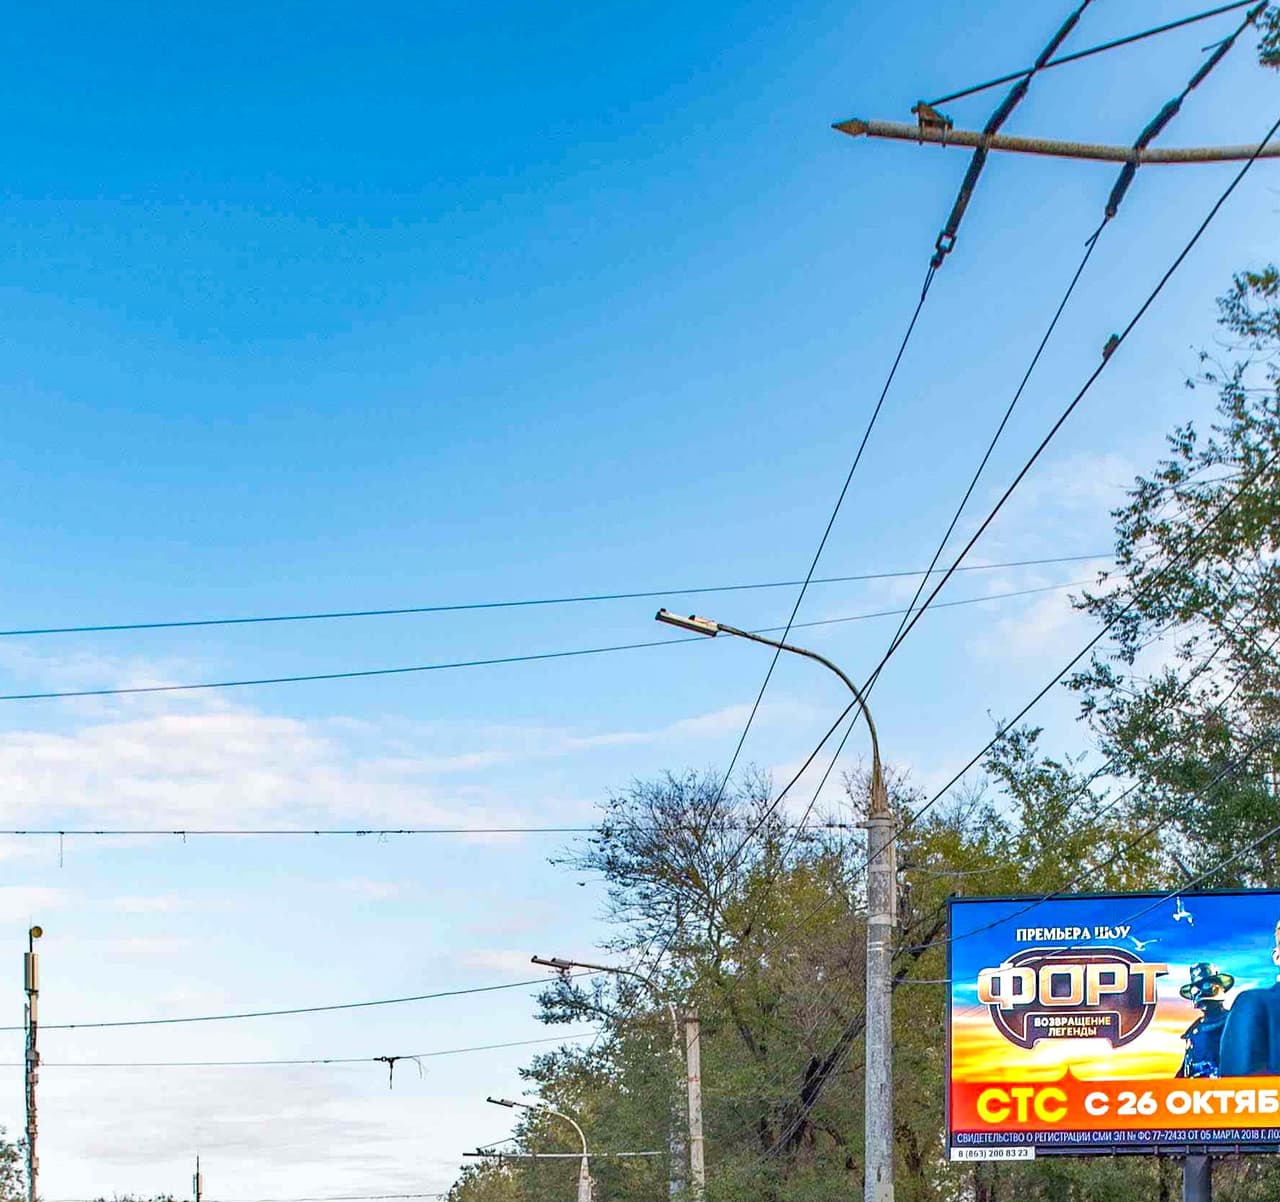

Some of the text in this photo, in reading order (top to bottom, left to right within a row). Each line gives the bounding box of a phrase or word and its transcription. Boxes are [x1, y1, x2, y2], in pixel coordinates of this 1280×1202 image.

[1016, 925, 1131, 942] ПРЕМЬЕРА ШОУ
[977, 962, 1170, 1010] ФОРТ
[1033, 1016, 1112, 1028] ВОЗВРАЩЕНИЕ
[1047, 1026, 1098, 1037] ЛЕГЕНДЫ
[976, 1087, 1069, 1124] СТС
[1084, 1091, 1110, 1116] С
[1116, 1091, 1158, 1115] 26
[957, 1132, 1025, 1144] СВИДЕТЕЛЬСТВО
[1026, 1132, 1034, 1142] О
[1035, 1131, 1090, 1143] РЕГИСТРАЦИИ
[1092, 1131, 1112, 1142] СМИ
[1188, 1129, 1198, 1139] ОТ
[1213, 1129, 1240, 1140] МАРТА
[1241, 1129, 1259, 1139] 2018
